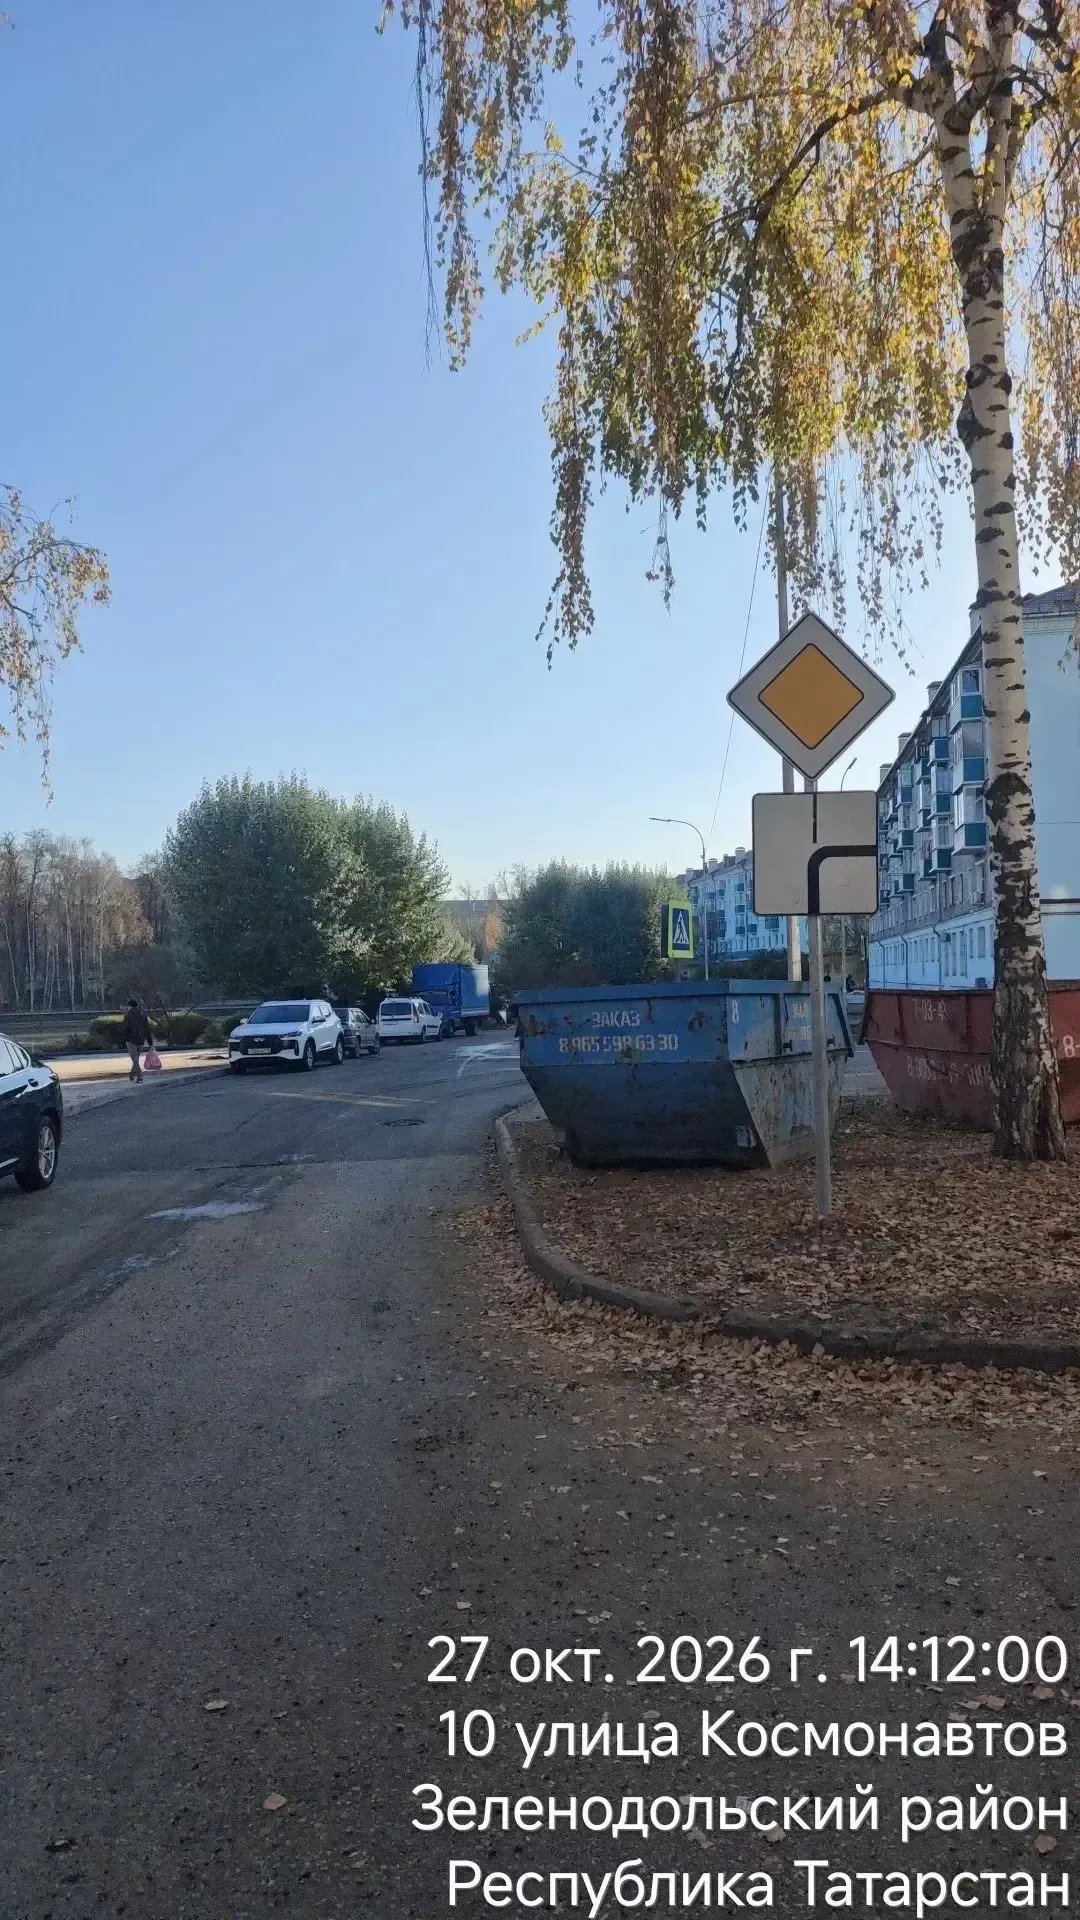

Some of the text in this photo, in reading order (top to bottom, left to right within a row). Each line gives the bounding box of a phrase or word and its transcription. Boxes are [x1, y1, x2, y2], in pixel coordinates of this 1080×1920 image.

[592, 1010, 641, 1028] ЗАКАЗ
[559, 1037, 569, 1052] 8
[657, 1033, 679, 1051] 30
